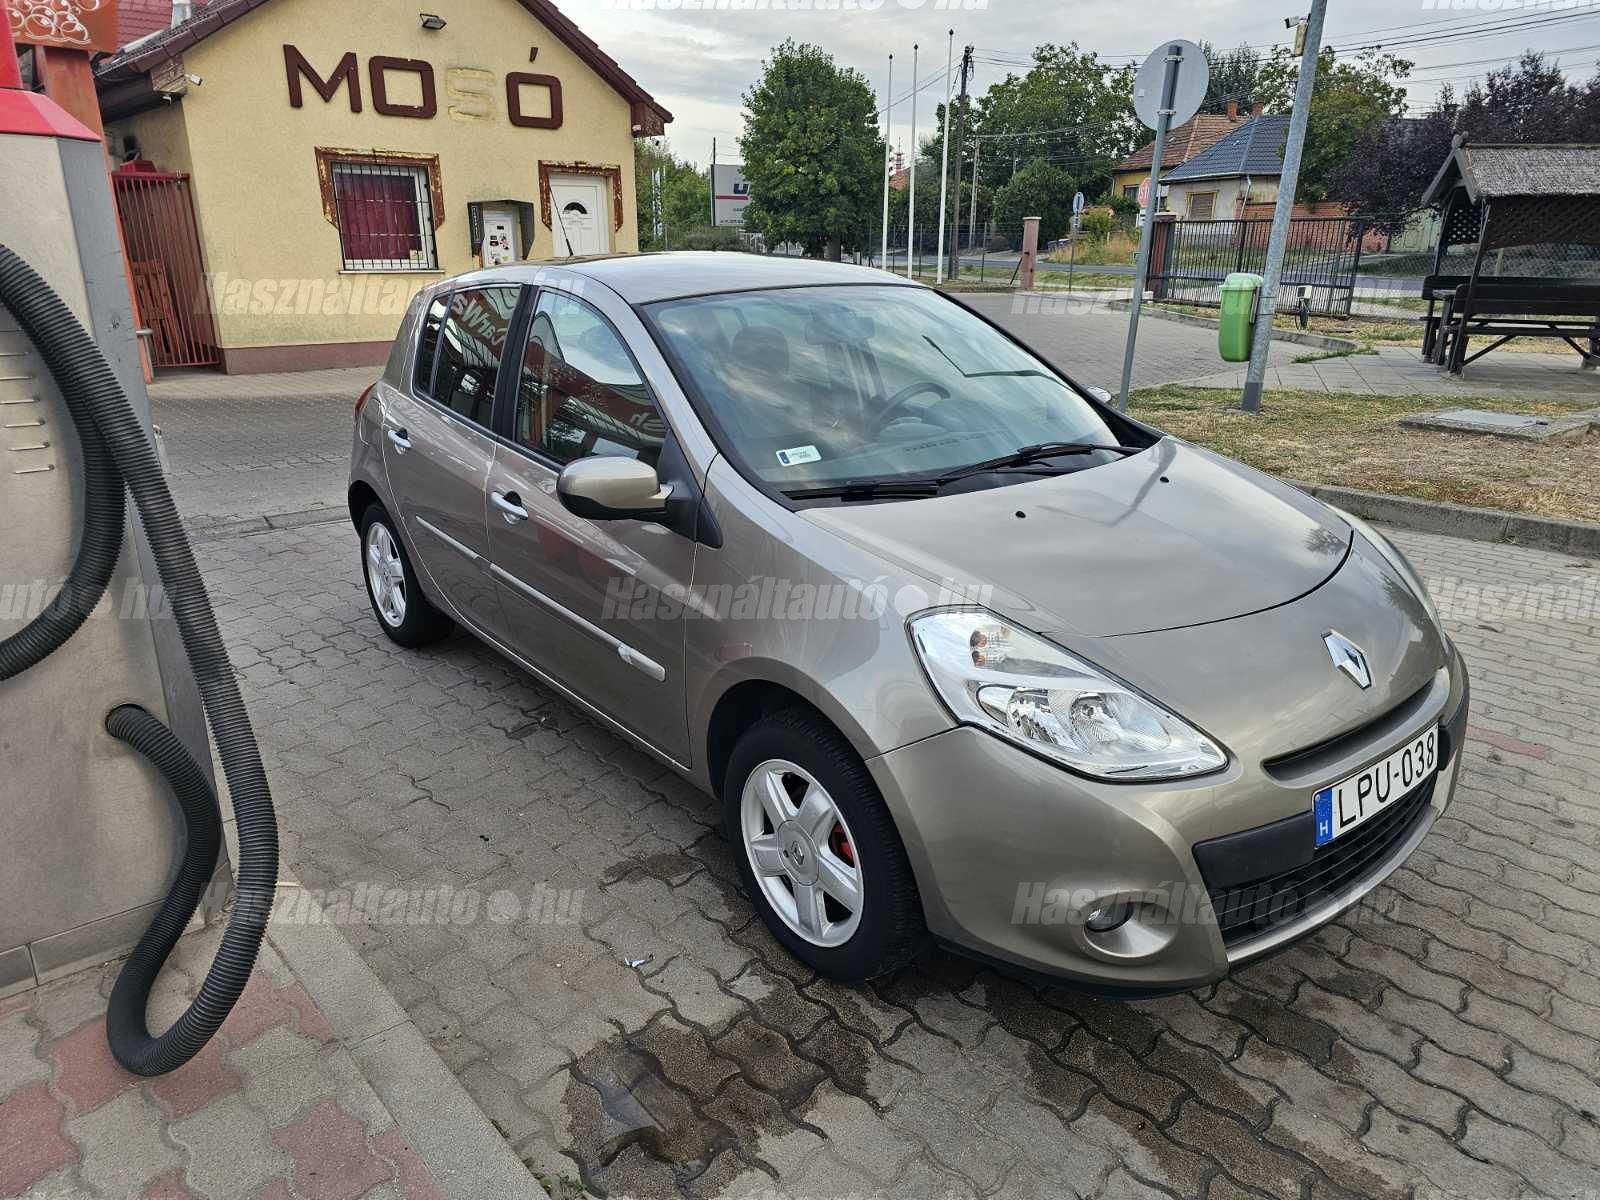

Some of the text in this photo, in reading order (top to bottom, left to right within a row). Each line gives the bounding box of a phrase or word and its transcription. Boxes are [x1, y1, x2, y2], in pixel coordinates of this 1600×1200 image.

[283, 44, 564, 130] MOSÓ
[1319, 731, 1435, 837] H LPU-038
